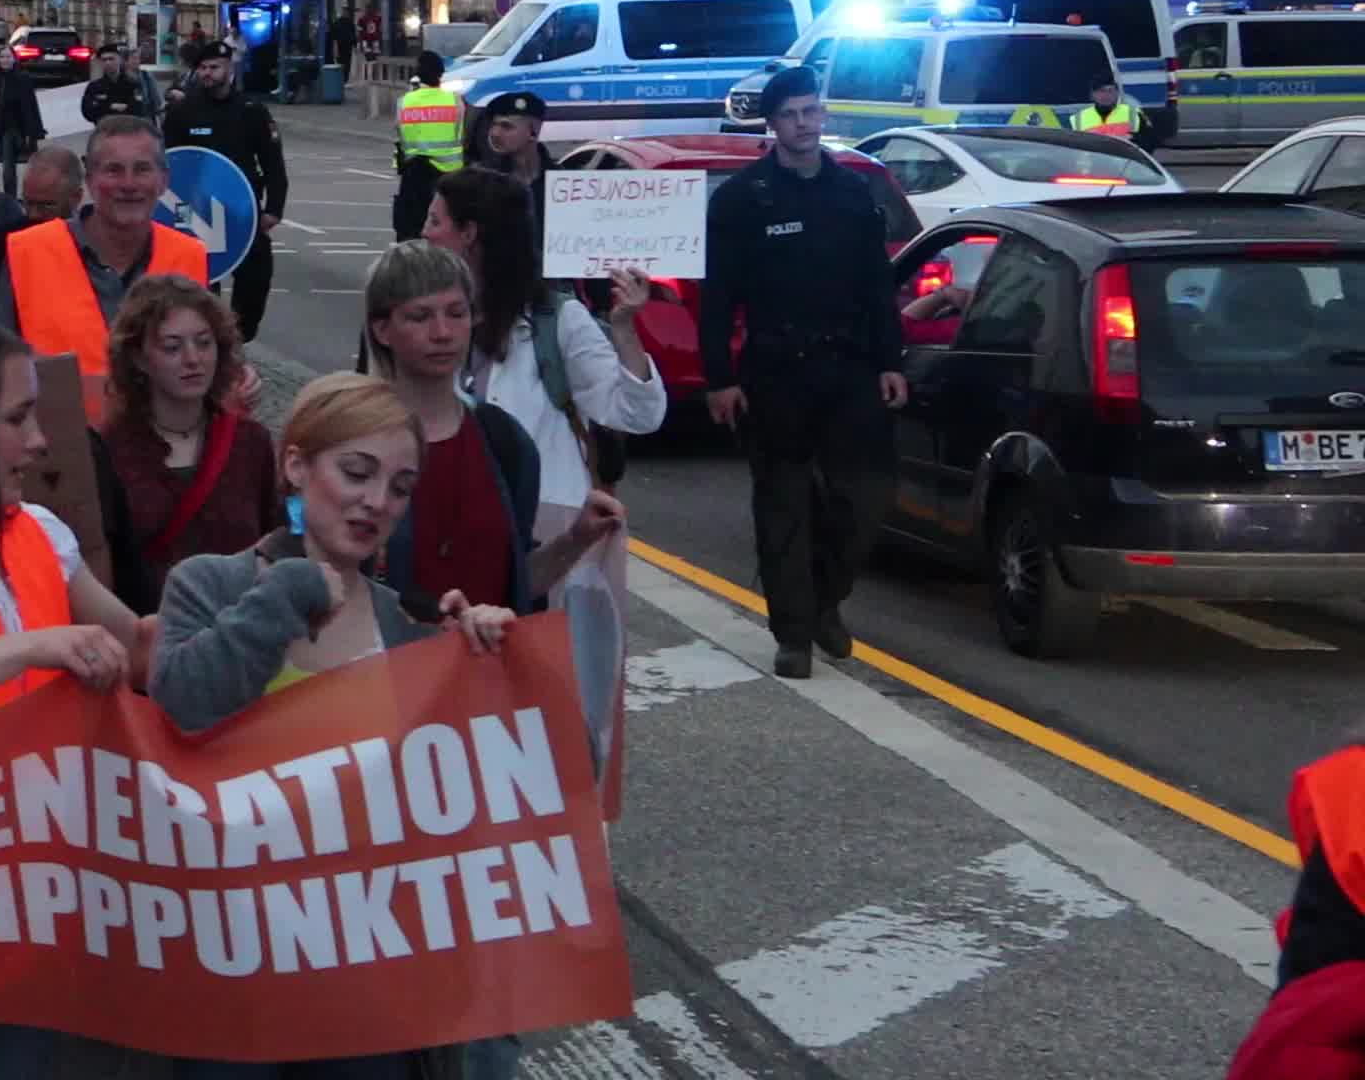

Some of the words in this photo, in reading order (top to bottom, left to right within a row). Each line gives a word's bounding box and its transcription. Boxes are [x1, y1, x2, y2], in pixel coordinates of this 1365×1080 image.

[635, 86, 687, 97] POLIZEI
[551, 177, 701, 203] GESUNDHEIT
[1282, 435, 1300, 460] M
[1318, 434, 1353, 460] BE
